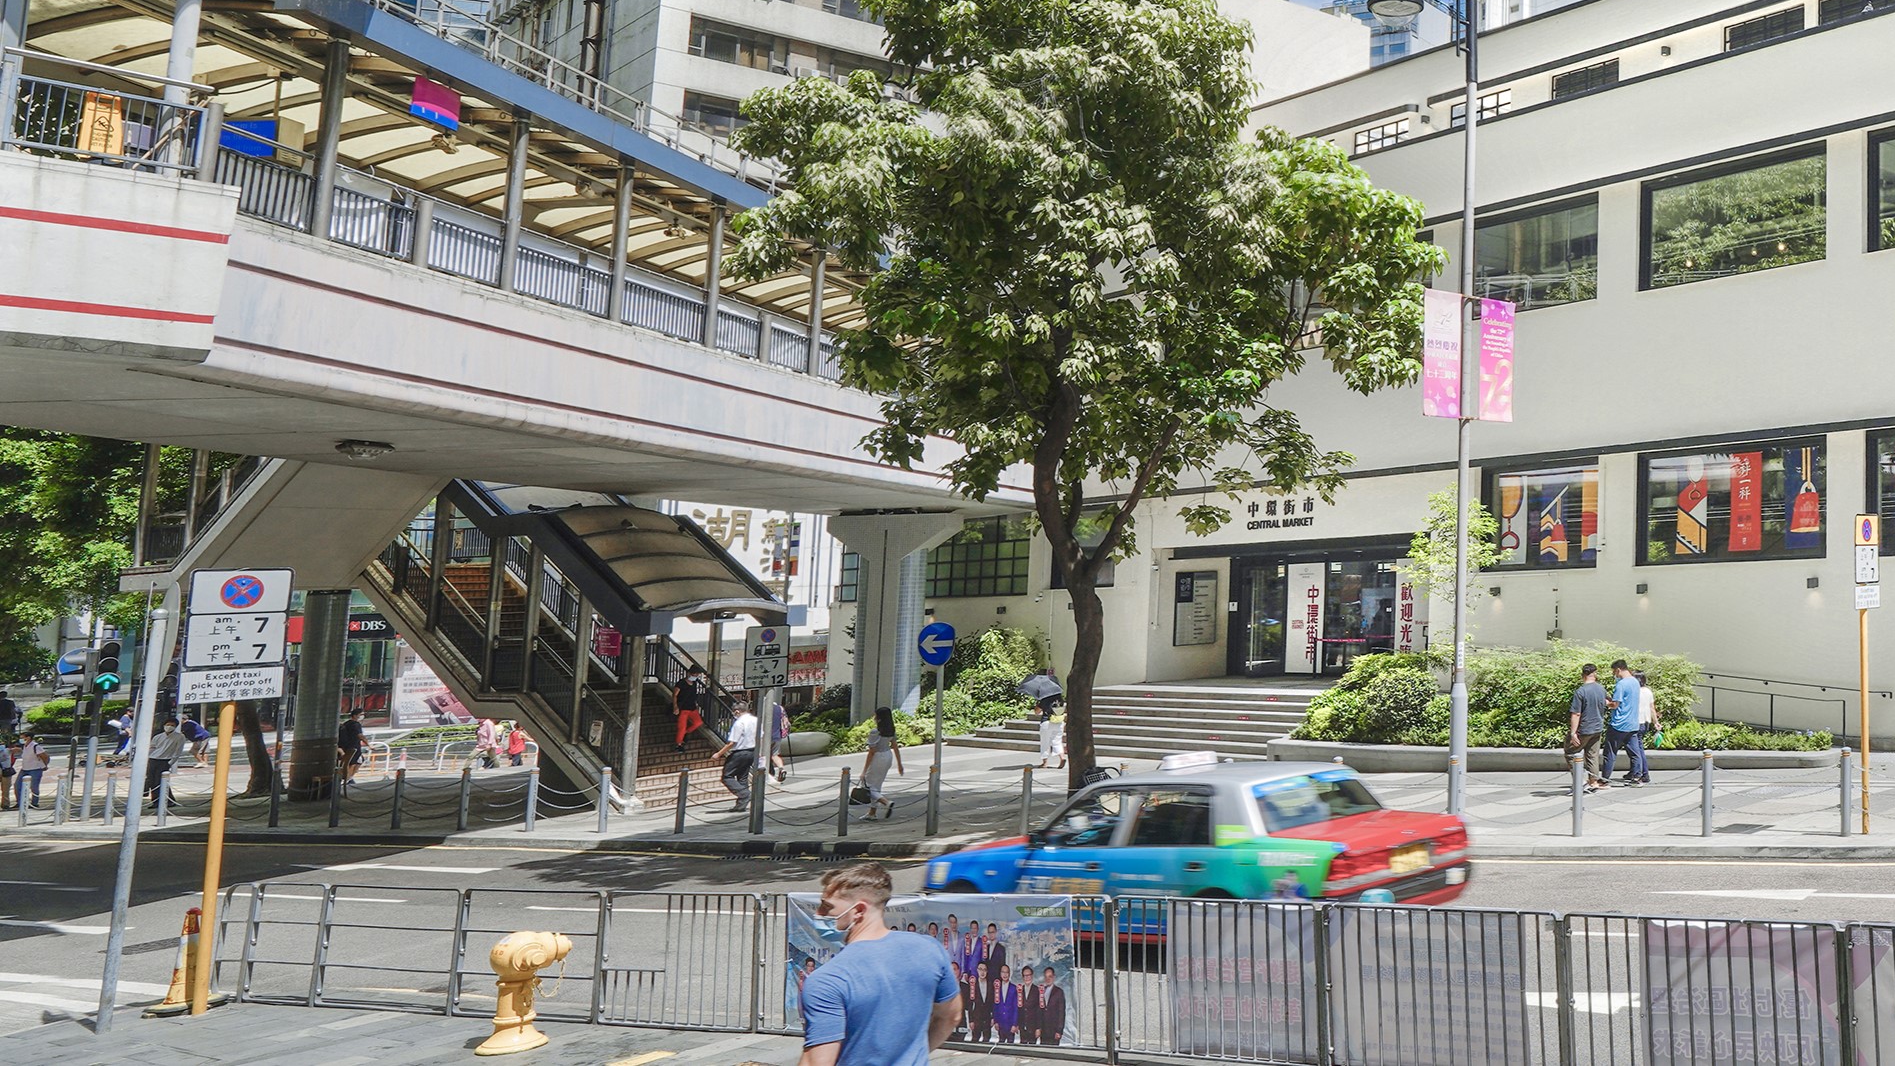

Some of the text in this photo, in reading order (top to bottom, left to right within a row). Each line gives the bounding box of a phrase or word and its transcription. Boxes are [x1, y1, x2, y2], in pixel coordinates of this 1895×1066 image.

[1247, 496, 1314, 518] 中環街市
[1247, 517, 1314, 530] CENTRAL MARKET
[209, 625, 237, 635] 上午
[254, 617, 269, 633] 7
[361, 620, 386, 631] DBS
[1306, 584, 1319, 664] 中環街市
[207, 652, 235, 662] 下午
[212, 643, 267, 660] pm 7
[772, 660, 779, 669] 7
[205, 671, 261, 681] Except taxi
[771, 674, 785, 684] 12
[191, 677, 272, 691] pick up/drop off
[184, 687, 276, 701] 的士上落客除外
